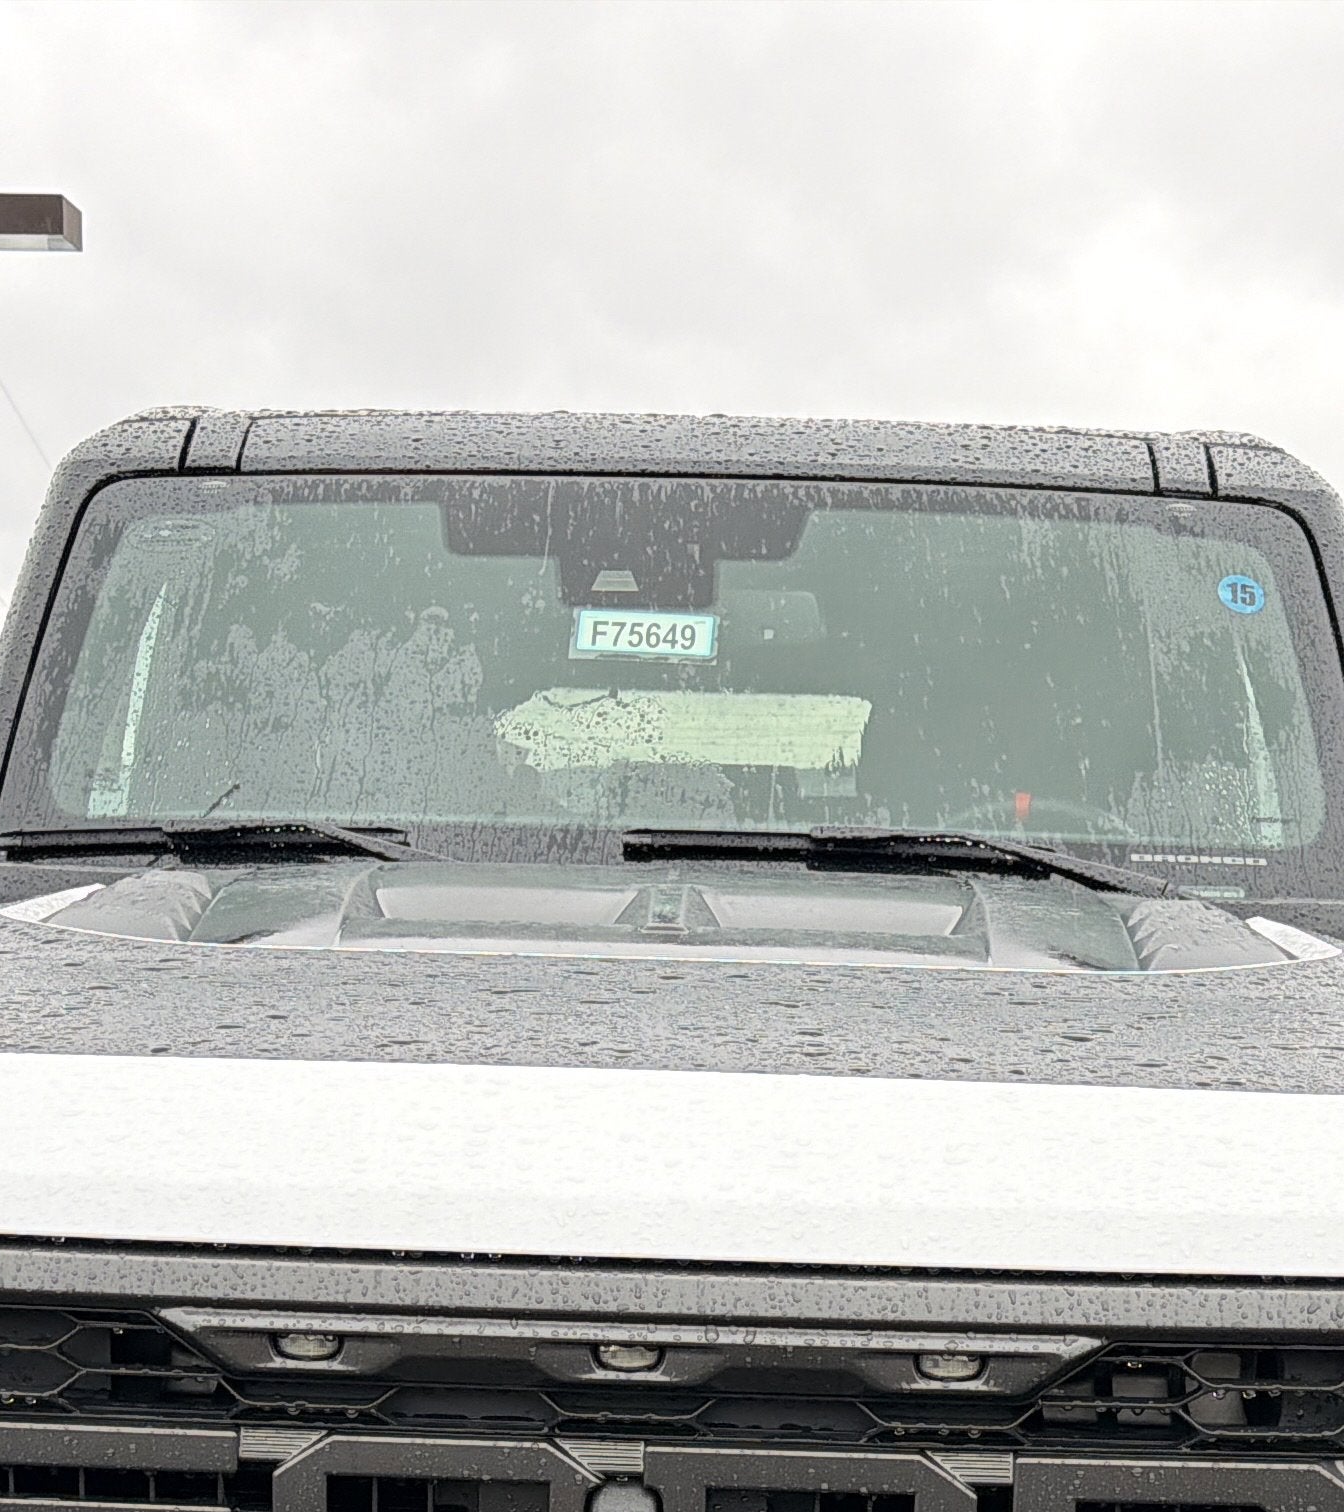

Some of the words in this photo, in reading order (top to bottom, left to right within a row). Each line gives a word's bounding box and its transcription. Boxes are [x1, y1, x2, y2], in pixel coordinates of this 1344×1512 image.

[1226, 582, 1256, 607] 15
[590, 619, 697, 651] F75649
[1130, 853, 1268, 867] BRONCO
